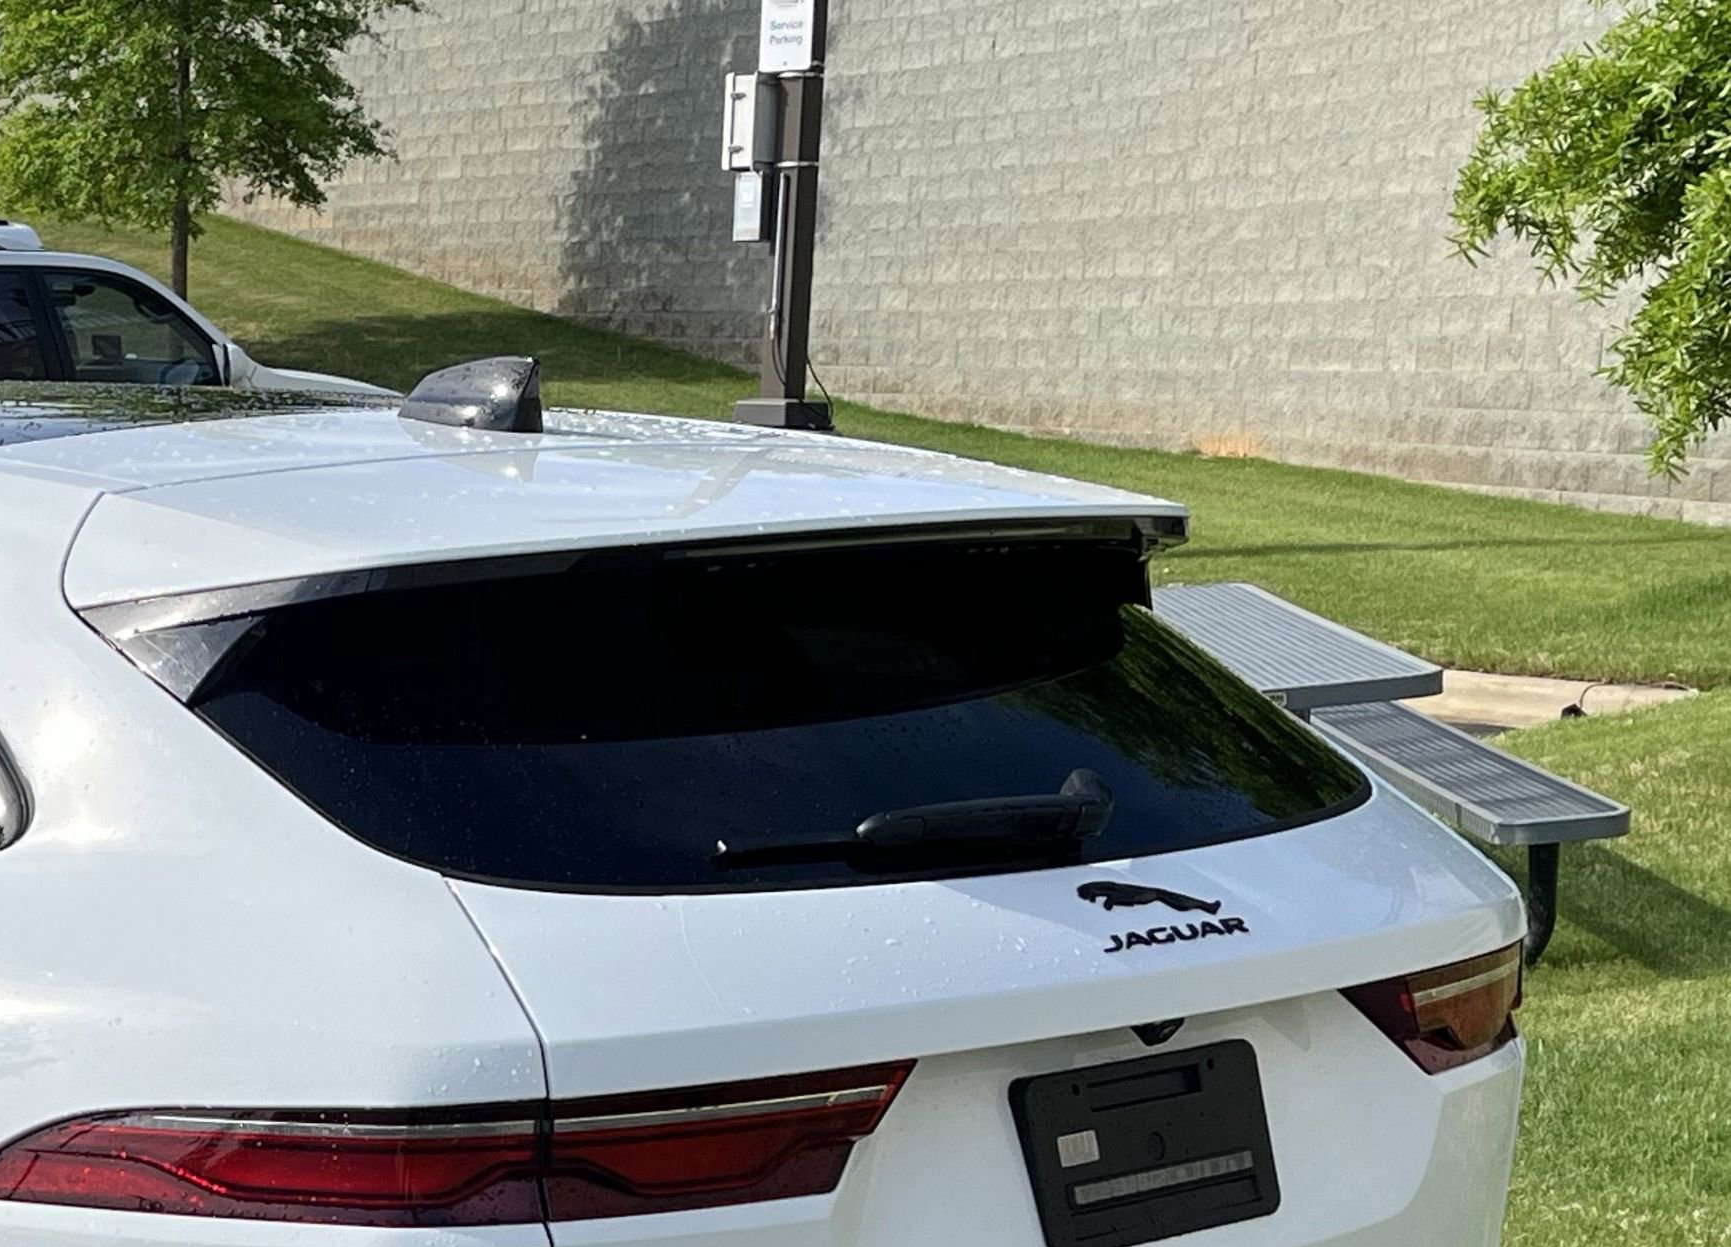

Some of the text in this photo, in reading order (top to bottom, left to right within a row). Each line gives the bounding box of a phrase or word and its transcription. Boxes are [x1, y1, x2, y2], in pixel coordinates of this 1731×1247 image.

[770, 20, 803, 30] Service
[769, 35, 804, 46] Parking
[1103, 917, 1249, 953] JAGUAR
